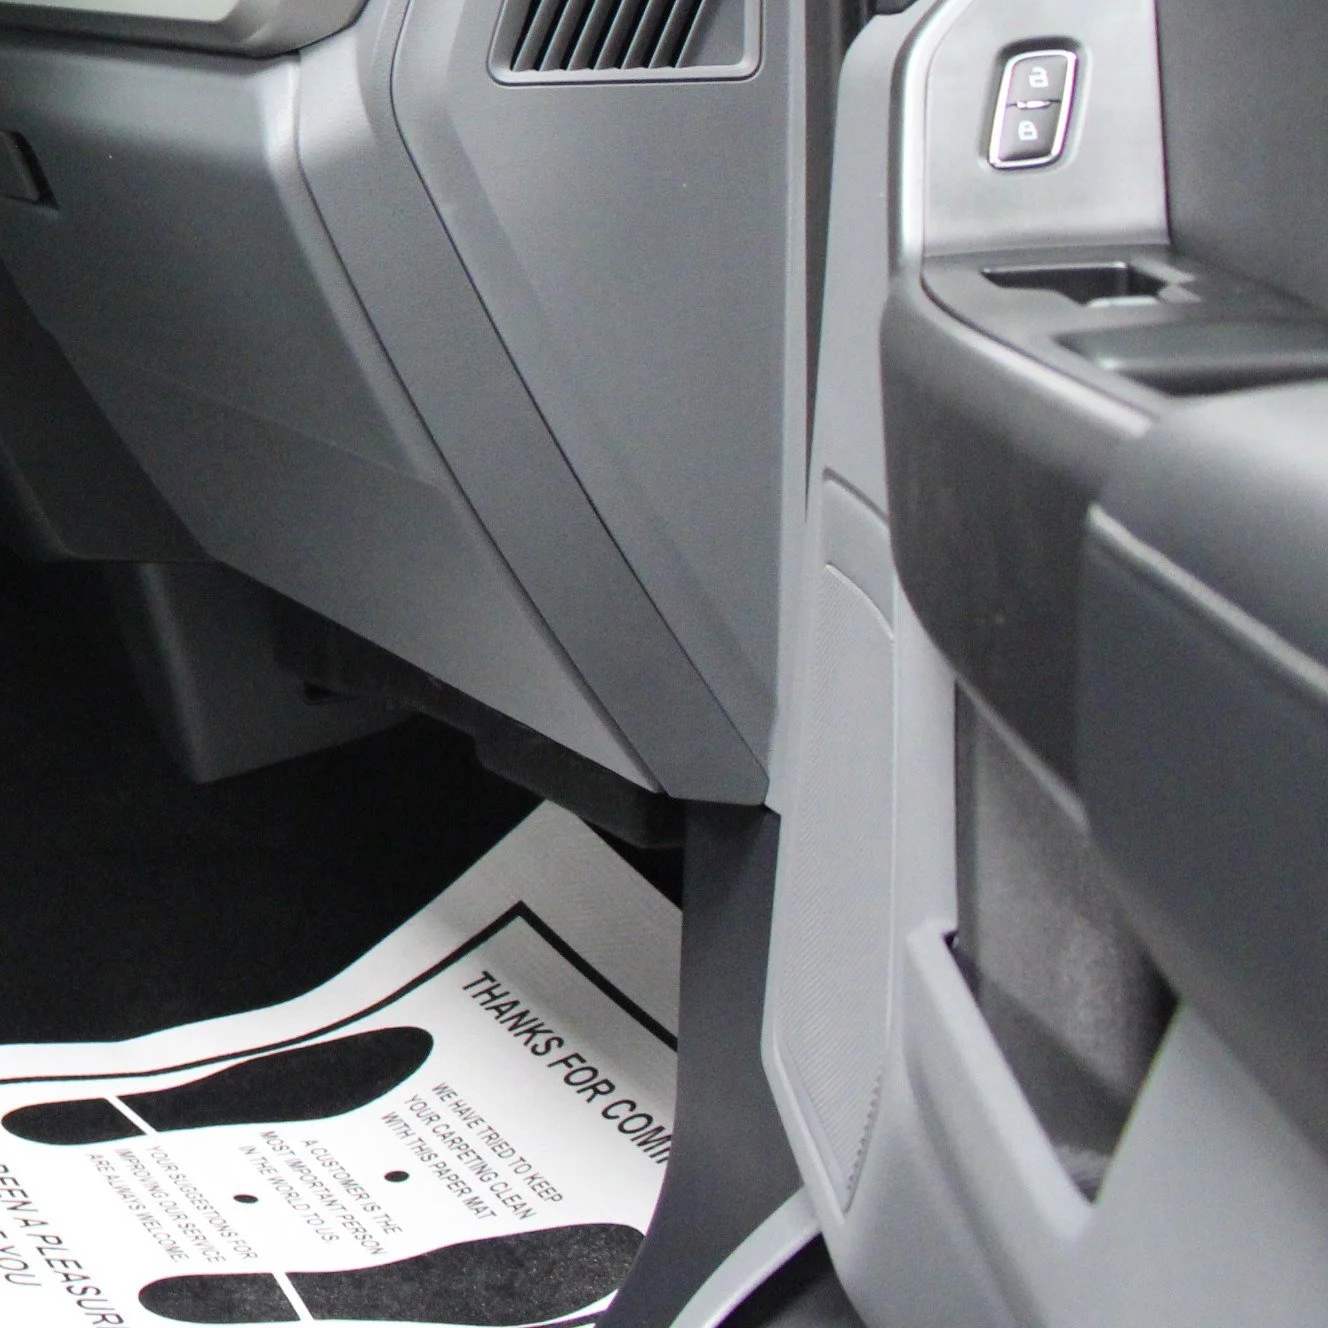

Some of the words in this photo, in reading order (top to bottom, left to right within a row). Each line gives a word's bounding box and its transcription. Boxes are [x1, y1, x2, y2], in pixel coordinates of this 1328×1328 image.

[462, 970, 564, 1056] THANKS
[547, 1052, 616, 1103] FOR
[601, 1099, 672, 1164] COMI
[86, 1153, 115, 1173] ARE
[106, 1174, 146, 1211] ALWAYS
[238, 1145, 260, 1155] IN
[250, 1156, 278, 1175] THE
[267, 1176, 310, 1211] WORLD
[301, 1212, 325, 1226] TO
[260, 1130, 296, 1156] MOST
[284, 1158, 348, 1212] IMPORTANT
[336, 1214, 388, 1255] PERSON
[301, 1139, 318, 1148] A
[310, 1147, 370, 1201] CUSTOMER
[360, 1202, 381, 1213] IS
[372, 1213, 403, 1235] THE
[381, 1111, 416, 1139] WITH
[406, 1137, 438, 1163] THIS
[429, 1161, 472, 1198] PAPER
[463, 1195, 498, 1219] MAT
[404, 1094, 441, 1126] YOUR
[432, 1123, 498, 1183] CARPETING
[489, 1181, 537, 1220] CLEAN
[431, 1082, 457, 1102] WE
[448, 1099, 485, 1129] HAVE
[476, 1125, 516, 1159] TRIED
[508, 1156, 532, 1175] TO
[523, 1172, 563, 1202] KEEP
[13, 1217, 49, 1228] A
[114, 1148, 169, 1199] IMPROVING
[159, 1200, 188, 1221] OUR
[178, 1222, 226, 1263] SERVICE
[146, 1145, 179, 1172] YOUR
[169, 1173, 238, 1238] SUGGESTIONS
[230, 1239, 258, 1260] FOR
[27, 1234, 131, 1328] PLEASUR
